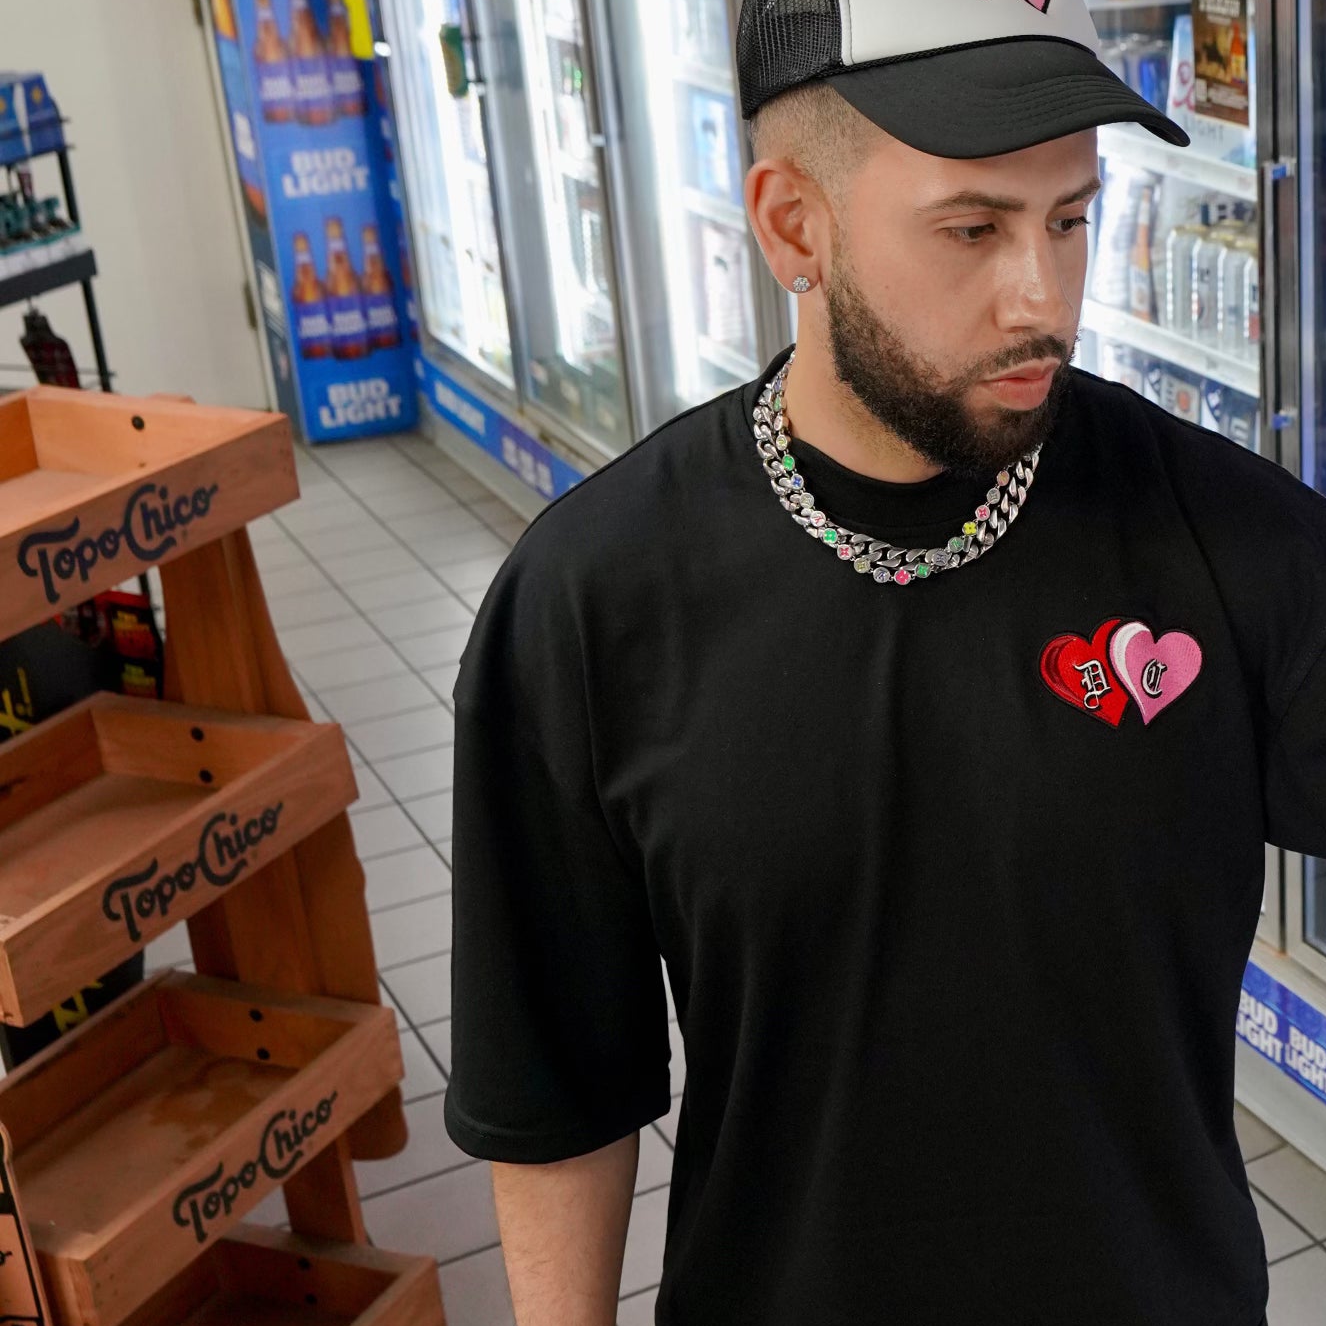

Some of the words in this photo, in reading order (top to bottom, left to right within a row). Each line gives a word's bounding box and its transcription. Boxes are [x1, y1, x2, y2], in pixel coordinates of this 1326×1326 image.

[291, 149, 356, 175] BUD
[283, 170, 371, 199] LIGHT
[328, 378, 389, 406] BUD
[320, 399, 402, 429] LIGHT
[17, 516, 122, 605] Topo
[122, 482, 219, 561] Chico
[102, 857, 200, 943] Topo
[198, 801, 284, 887] Chico
[1238, 990, 1279, 1034] BUD
[172, 1161, 260, 1244] Topo
[258, 1091, 338, 1180] Chico
